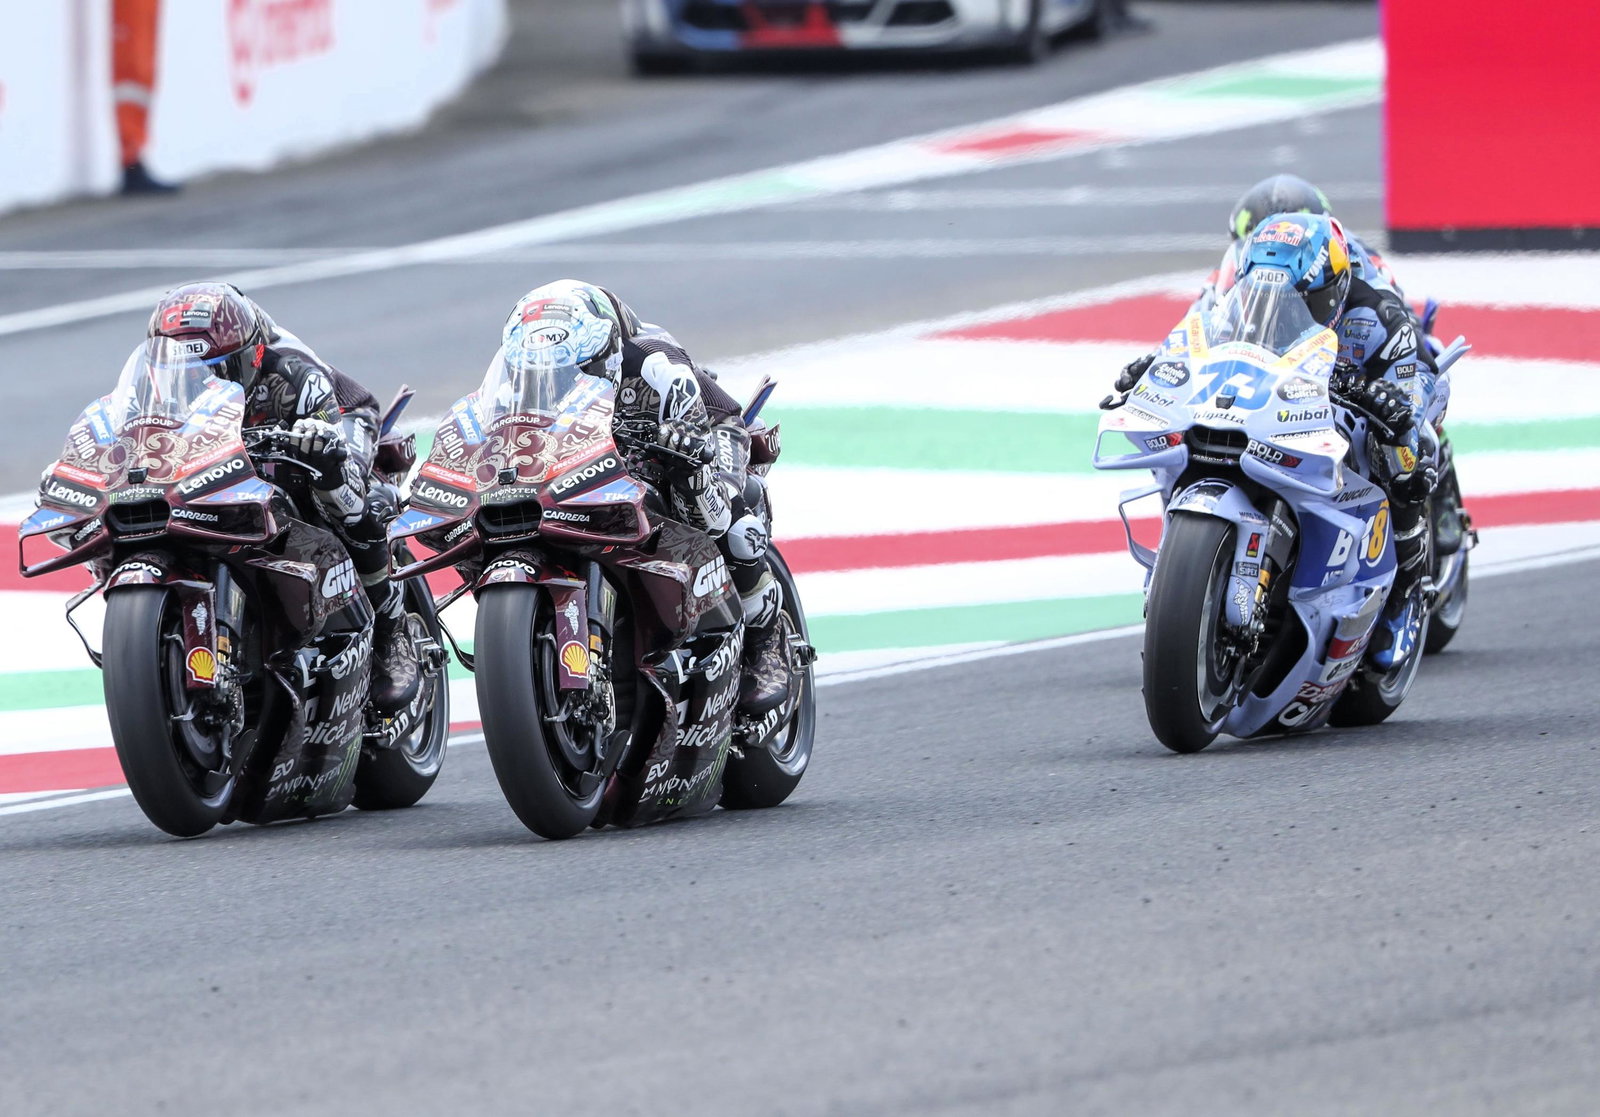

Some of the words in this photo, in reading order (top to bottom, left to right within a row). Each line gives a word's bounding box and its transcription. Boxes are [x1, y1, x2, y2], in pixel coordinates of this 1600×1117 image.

[183, 309, 209, 318] Lenovo
[1396, 365, 1414, 374] BOLD
[1186, 360, 1278, 410] 73
[1133, 384, 1174, 408] Unibat
[1277, 409, 1329, 423] Unibat
[438, 424, 465, 460] riello
[1146, 436, 1167, 449] BOLD
[1248, 439, 1283, 462] BOLD
[178, 459, 245, 495] Lenovo
[549, 457, 616, 495] Lenovo
[47, 482, 97, 507] Lenovo
[417, 482, 468, 508] Lenovo
[41, 515, 65, 530] TIM
[171, 508, 219, 522] CARRERA
[543, 510, 591, 523] CARRERA
[408, 517, 433, 531] TIM
[444, 520, 473, 543] CARRERA
[111, 561, 163, 577] enovo
[481, 559, 536, 576] enovo
